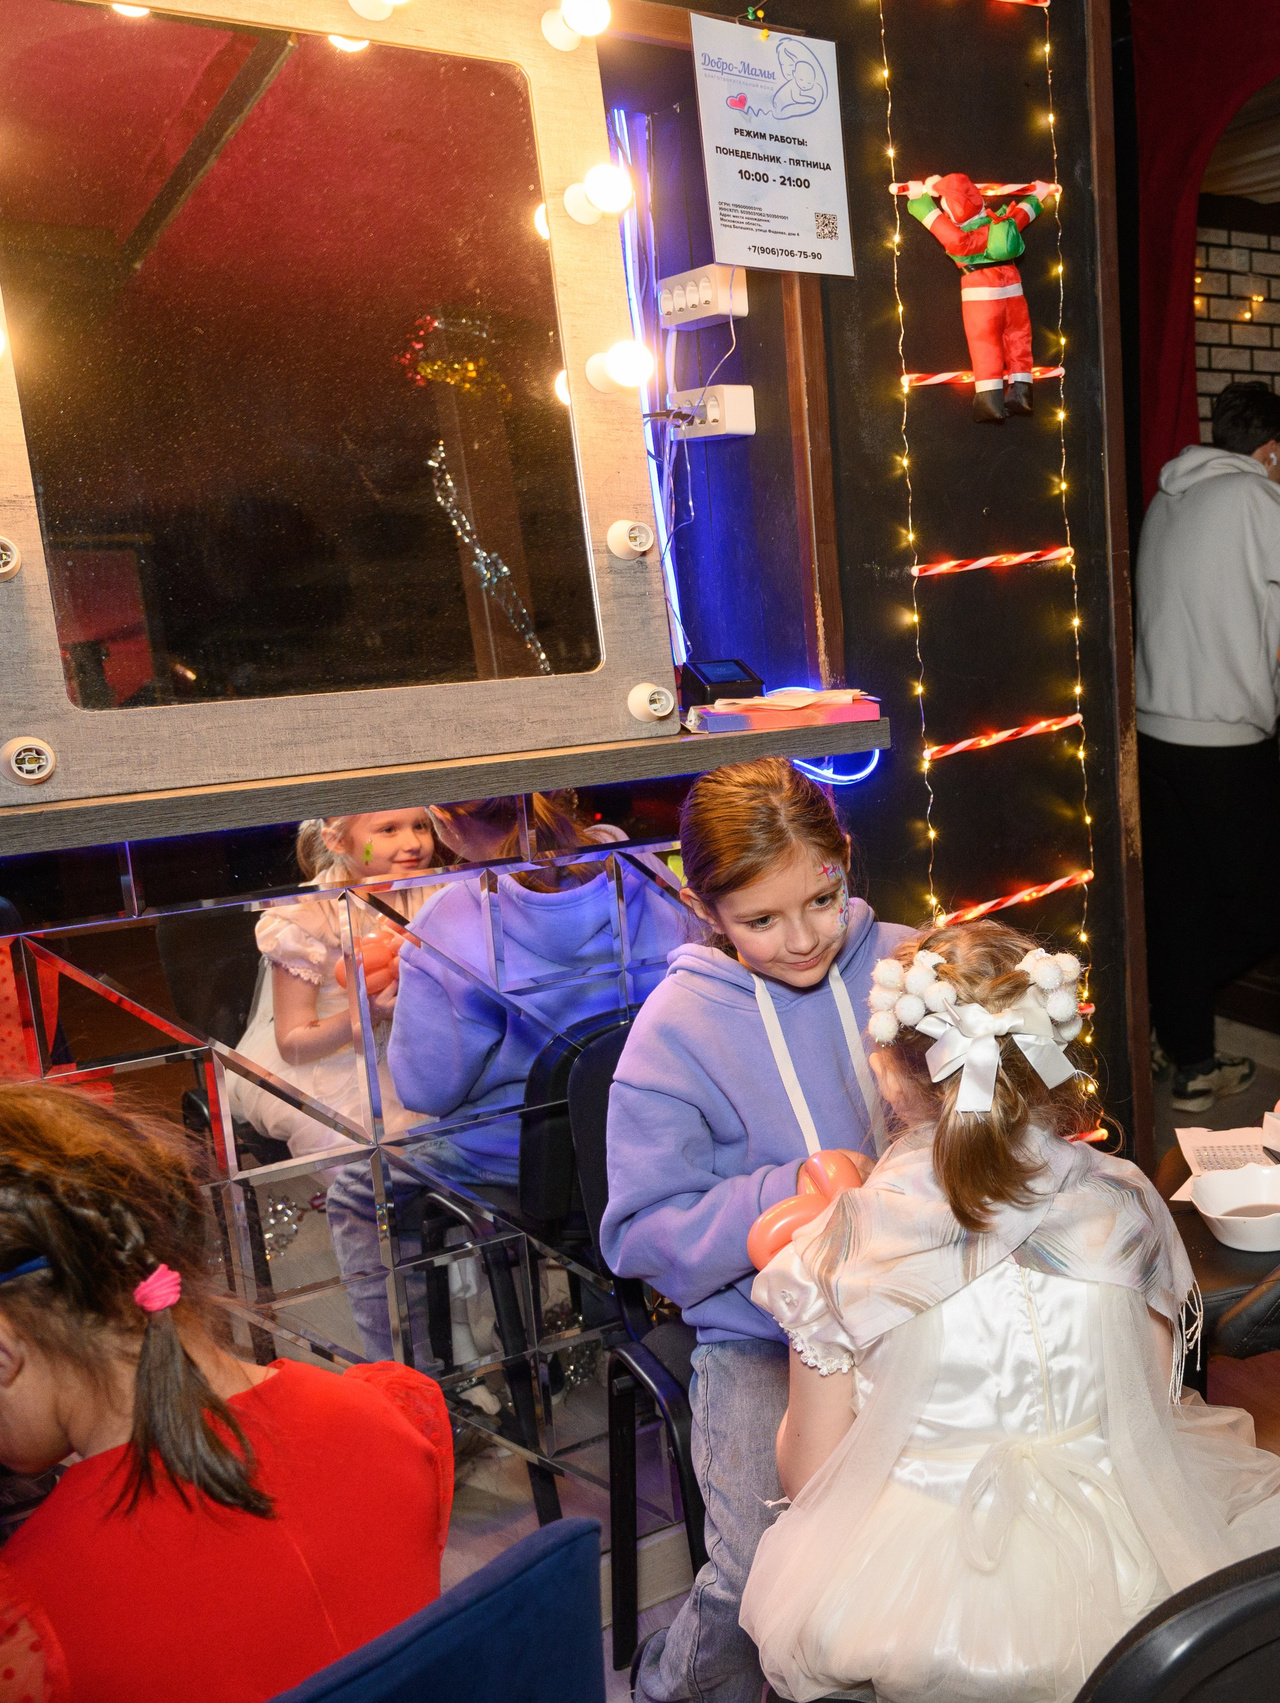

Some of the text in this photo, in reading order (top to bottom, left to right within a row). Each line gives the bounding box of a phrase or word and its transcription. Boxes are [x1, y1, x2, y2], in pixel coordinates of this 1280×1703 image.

[701, 52, 776, 80] Добро-Мамы
[733, 127, 808, 147] РЕЖИМ РАБОТЫ:
[715, 146, 782, 164] ПОНЕДЕЛЬНИК
[788, 158, 832, 171] ПЯТНИЦА
[738, 169, 769, 183] 10:00
[779, 175, 811, 189] 21:00
[720, 217, 744, 225] Московская
[747, 245, 823, 260] +7(906)706-75-90
